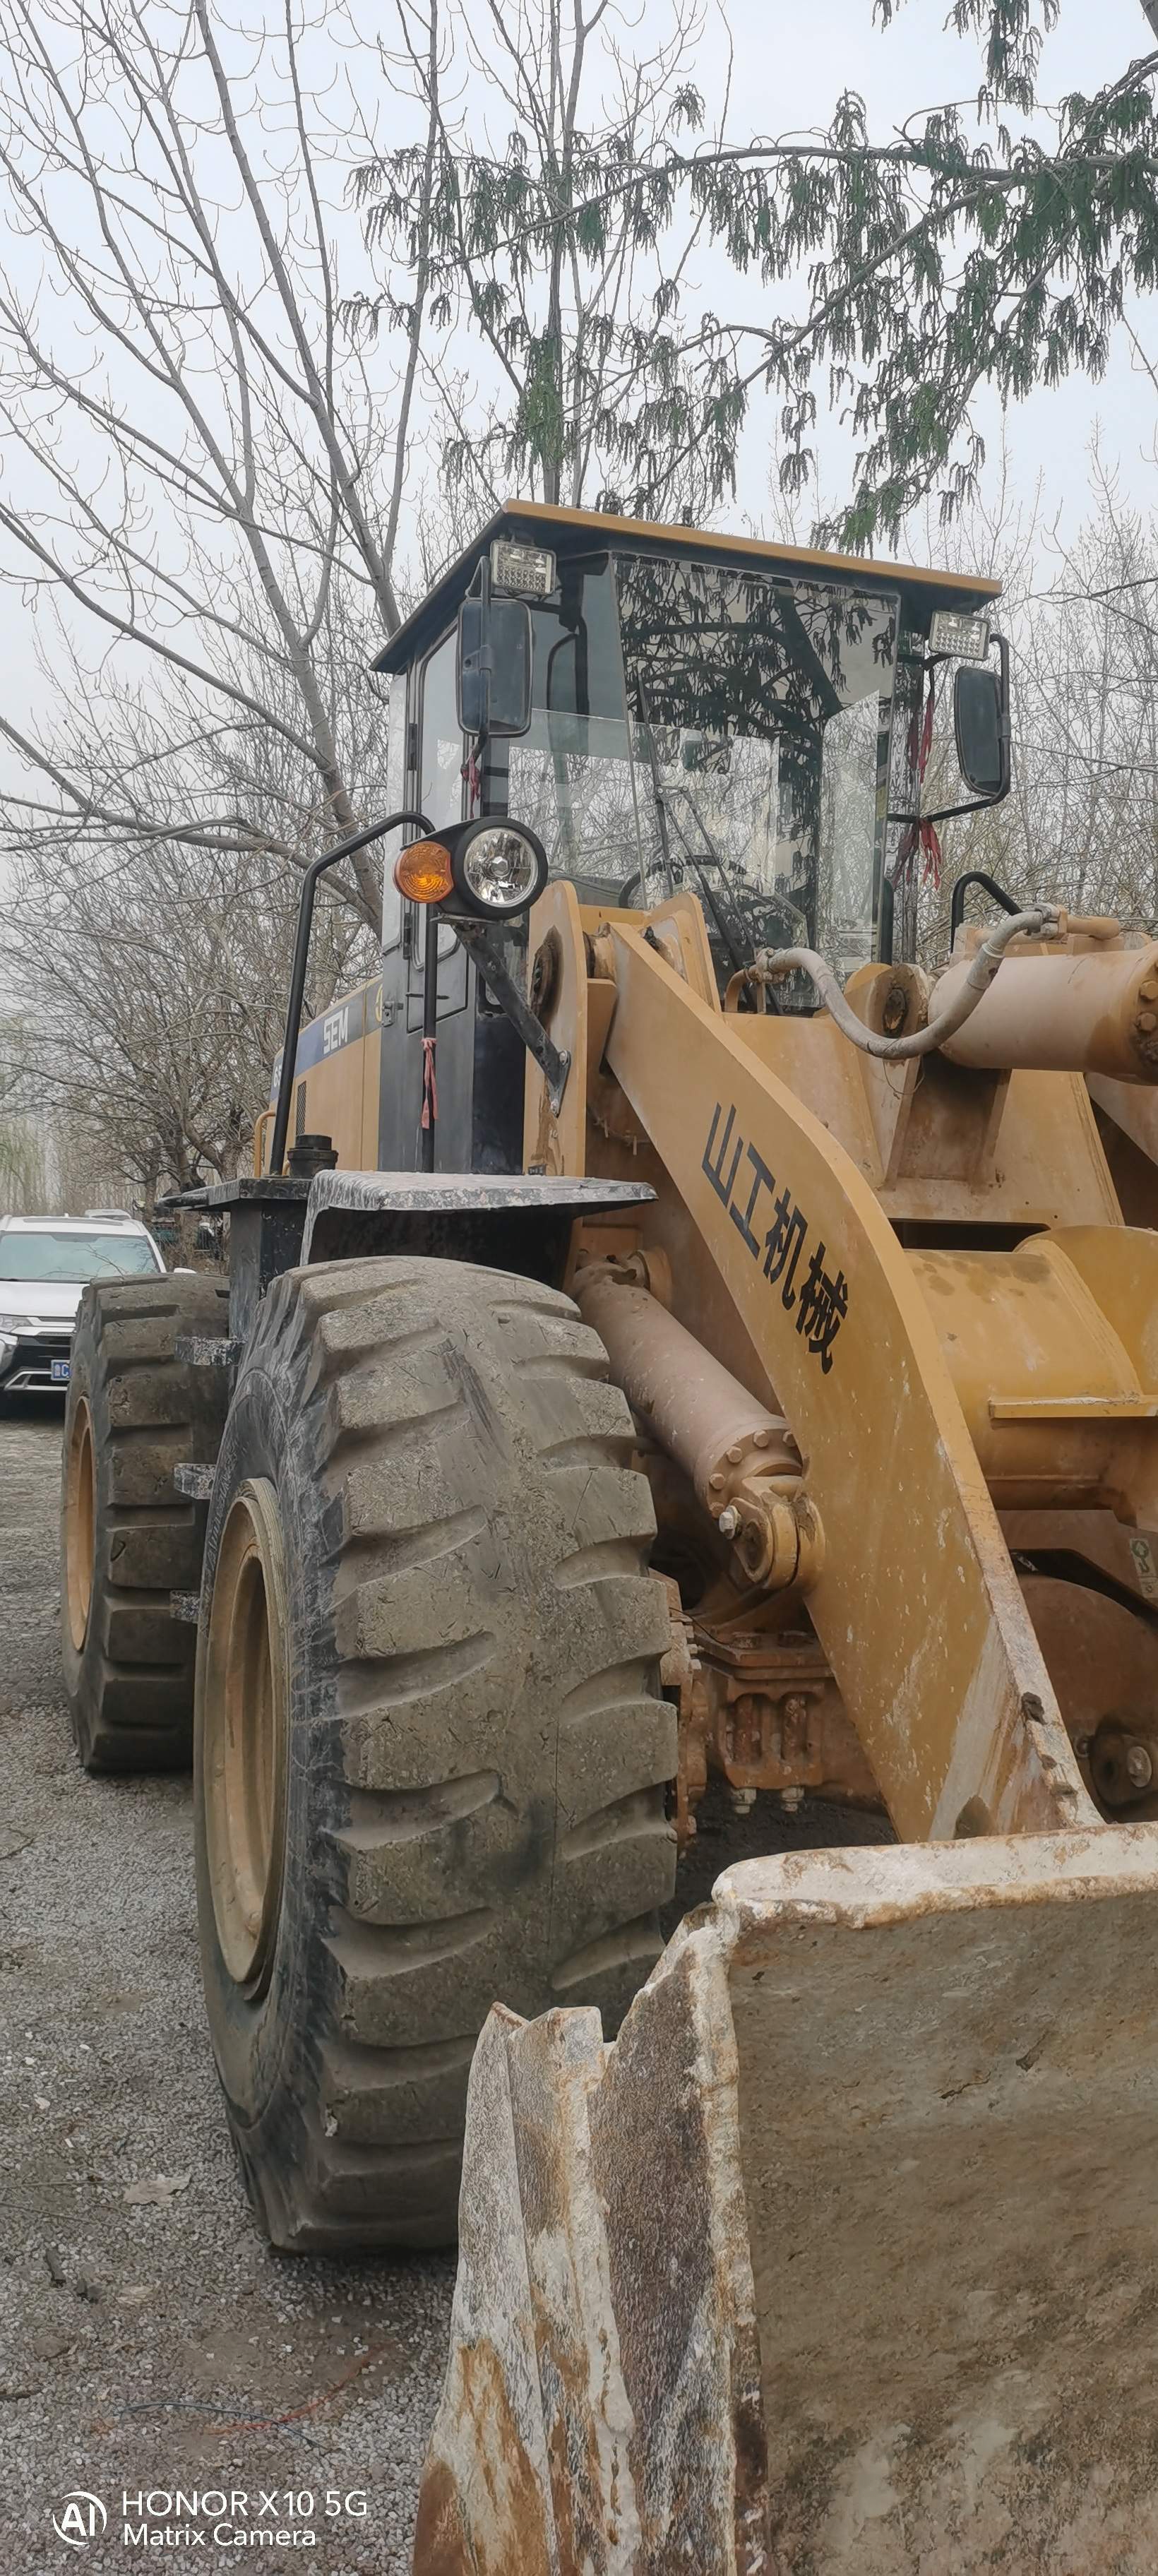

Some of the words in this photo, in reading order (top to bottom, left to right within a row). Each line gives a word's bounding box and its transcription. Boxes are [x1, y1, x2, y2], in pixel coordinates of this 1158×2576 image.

[323, 1006, 349, 1054] SEM
[702, 1102, 848, 1375] 山工机械
